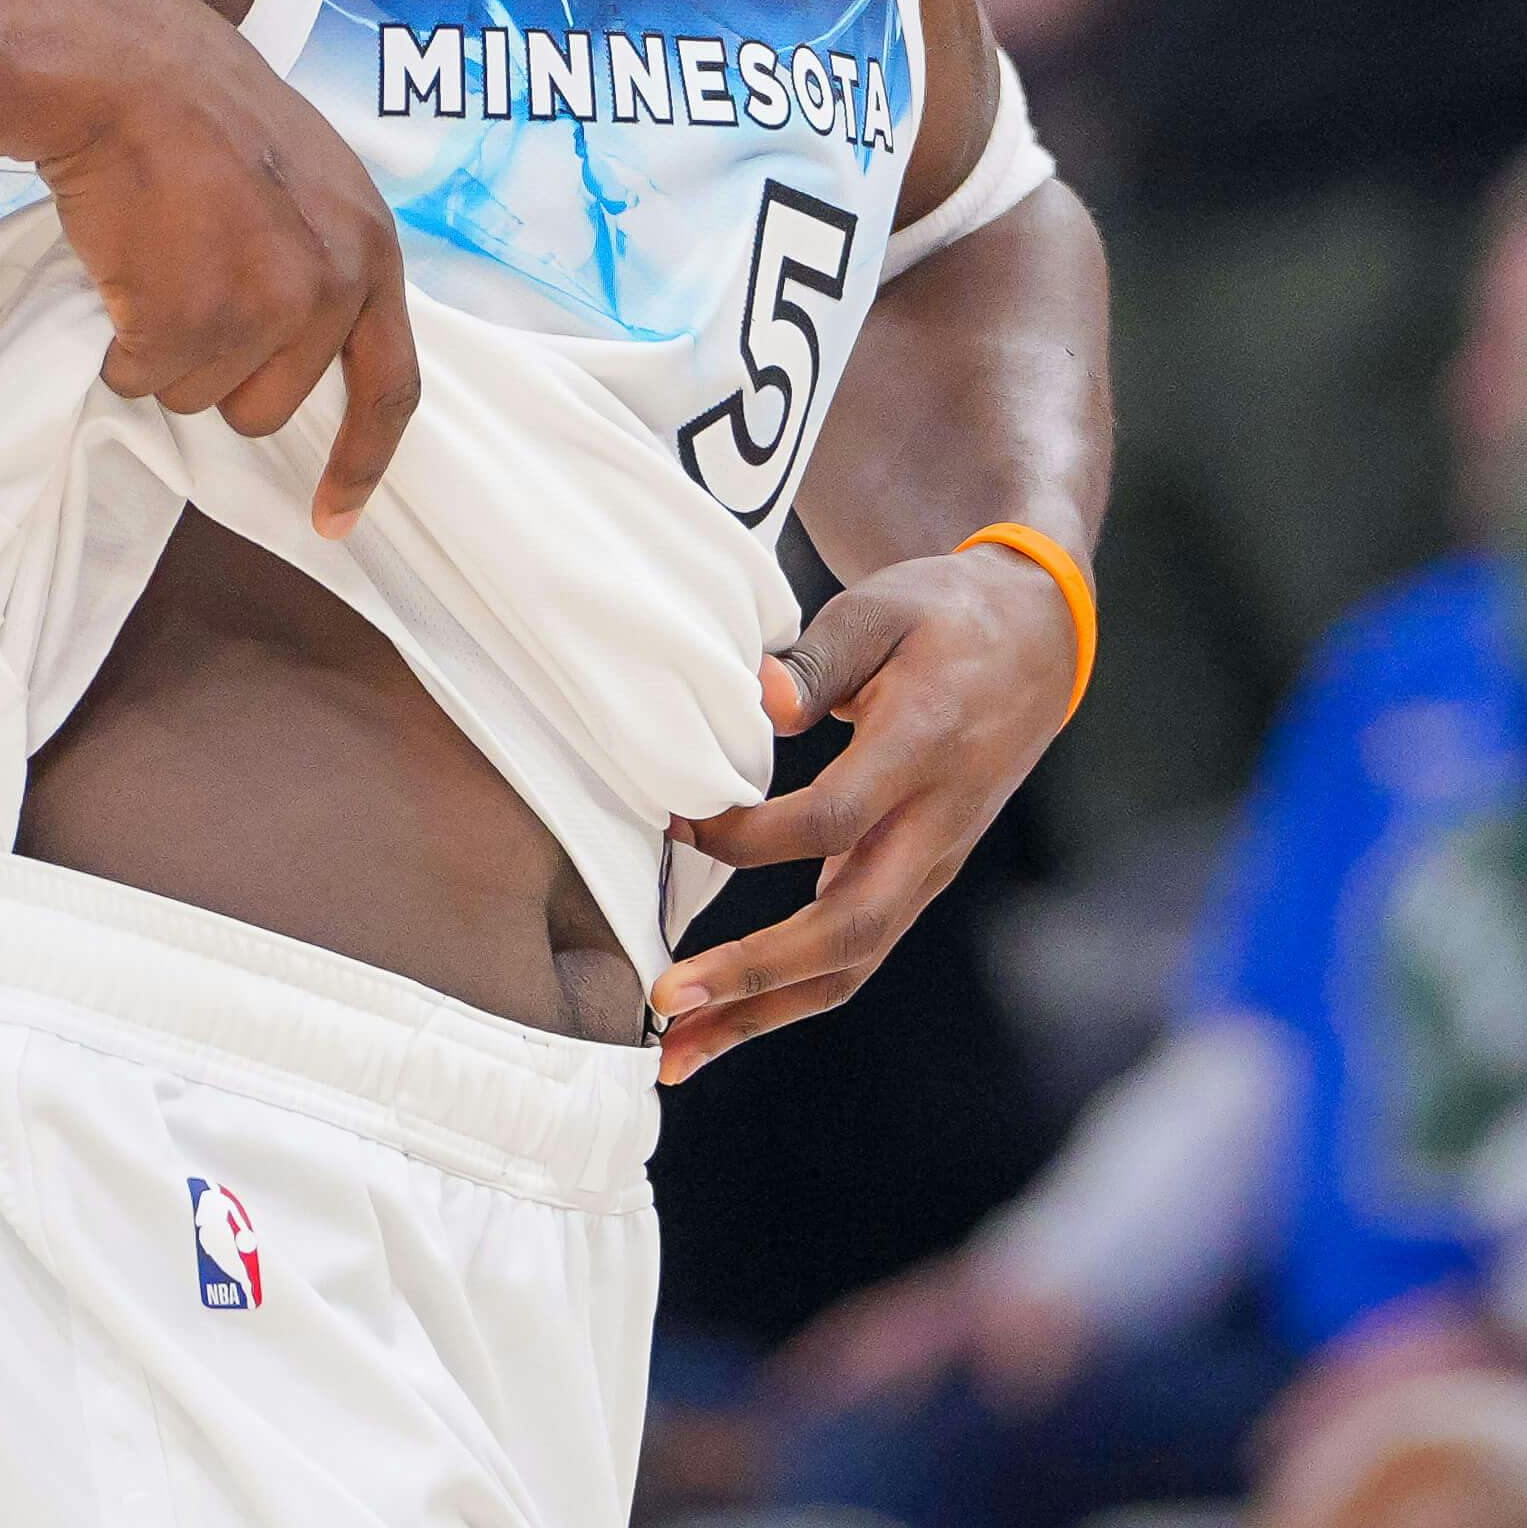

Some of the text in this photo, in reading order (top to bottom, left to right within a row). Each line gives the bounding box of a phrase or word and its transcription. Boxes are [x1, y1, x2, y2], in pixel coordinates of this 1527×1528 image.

[378, 24, 895, 154] MINNESOTA
[678, 178, 858, 529] 5
[206, 1283, 240, 1305] NBA
